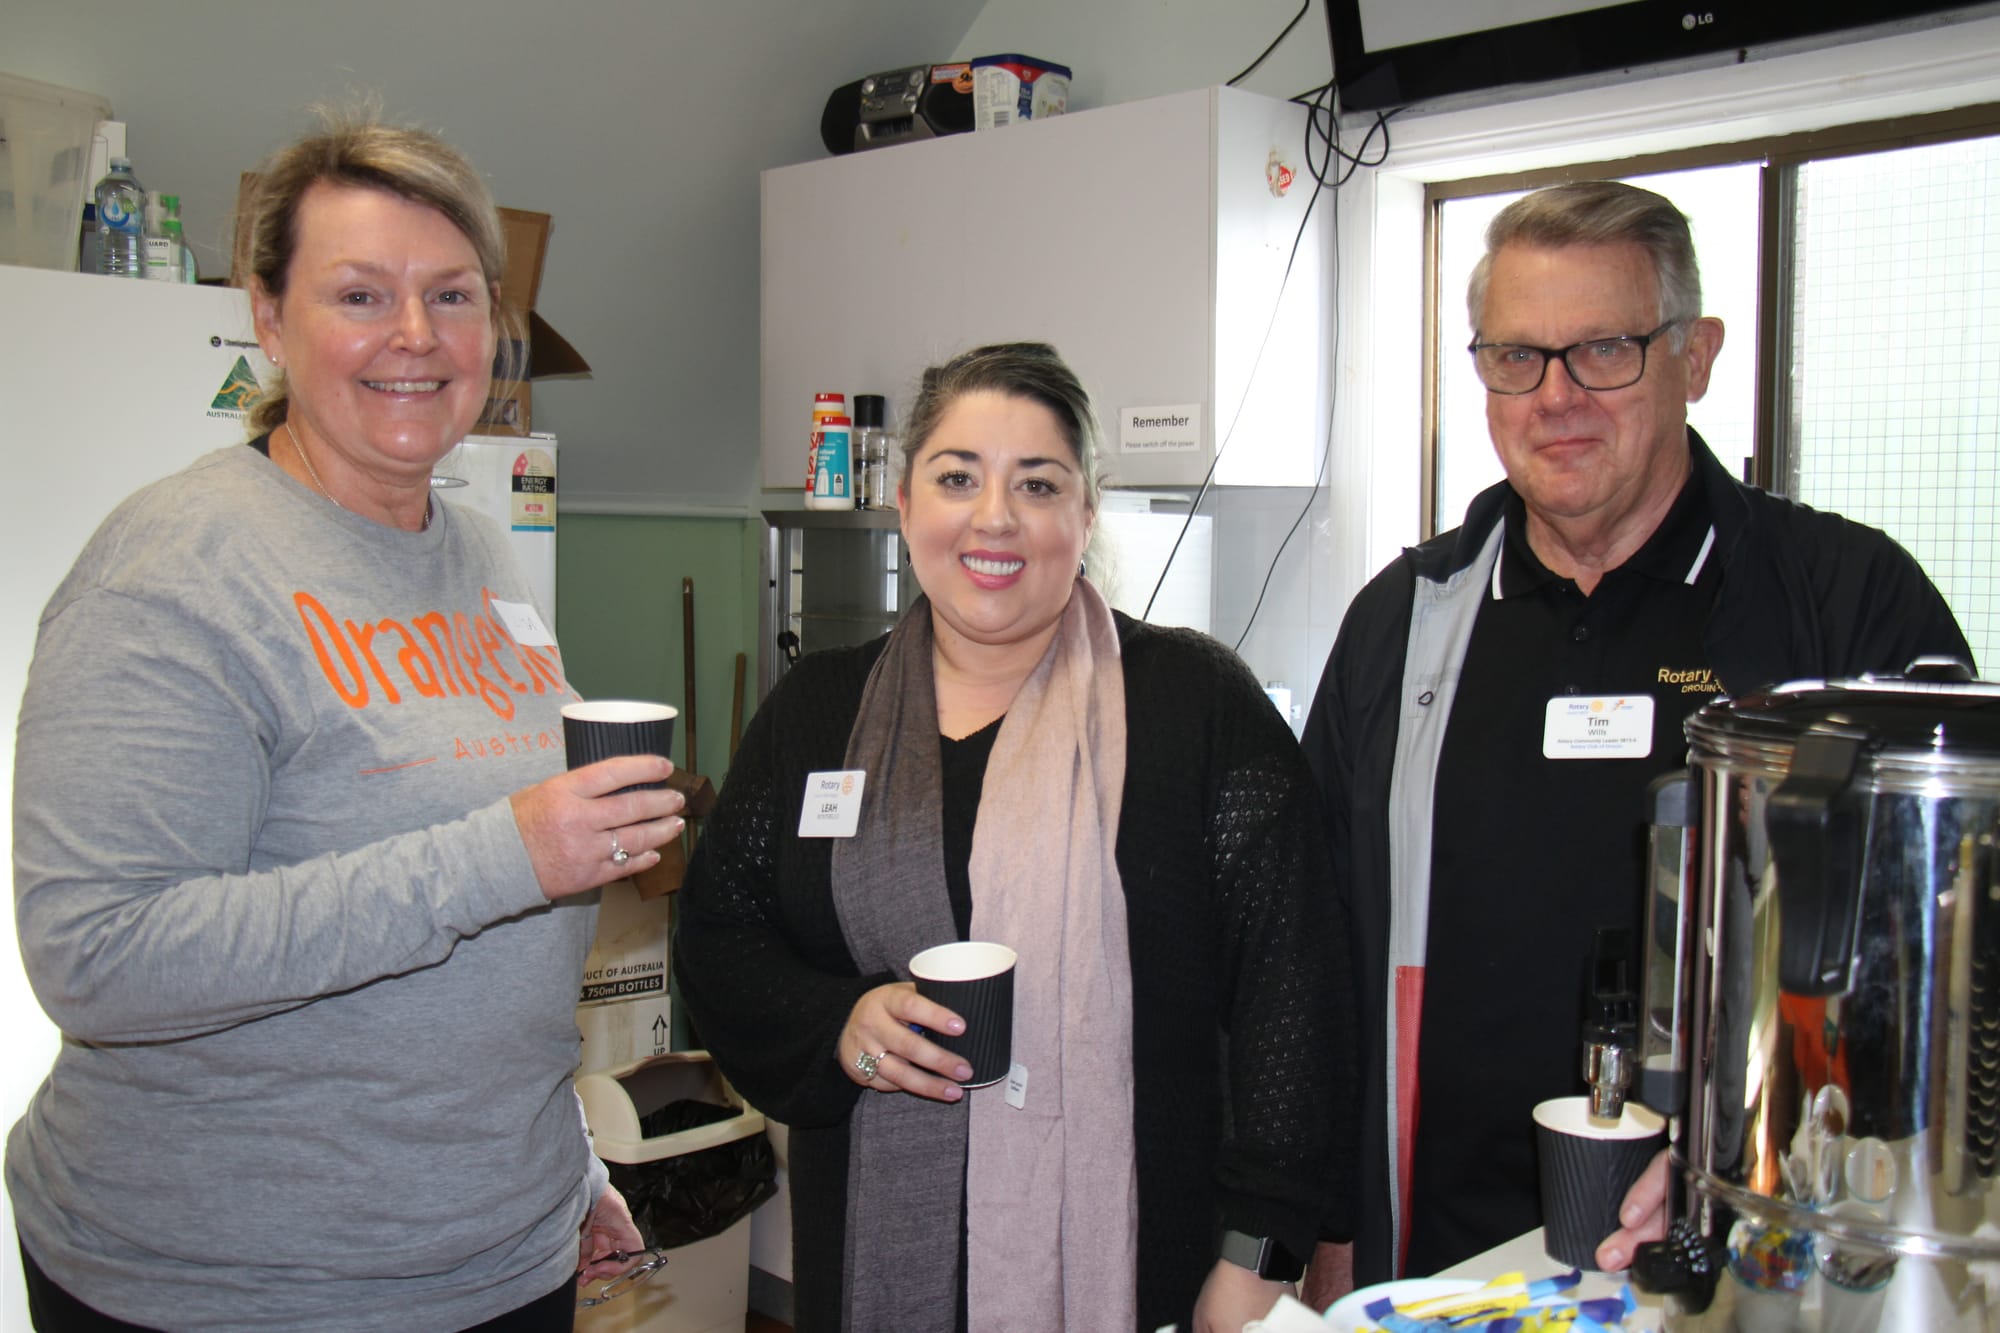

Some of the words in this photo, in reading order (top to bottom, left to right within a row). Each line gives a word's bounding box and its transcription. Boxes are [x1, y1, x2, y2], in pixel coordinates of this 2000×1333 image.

[1698, 13, 1713, 25] LG
[1132, 414, 1189, 428] Remember
[520, 477, 547, 485] ENERGY
[522, 484, 547, 492] RATING
[1657, 668, 1712, 684] Rotary
[1681, 684, 1717, 693] DROUIN
[1588, 717, 1609, 727] Tim
[454, 724, 564, 760] Austral
[820, 780, 840, 791] Rotary
[821, 803, 838, 813] LEAH
[584, 970, 603, 980] UCT
[606, 968, 618, 977] OF
[620, 961, 664, 976] AUSTRALIA
[587, 984, 617, 998] 750ml
[618, 978, 660, 993] BOTTLES
[653, 1048, 666, 1056] UP
